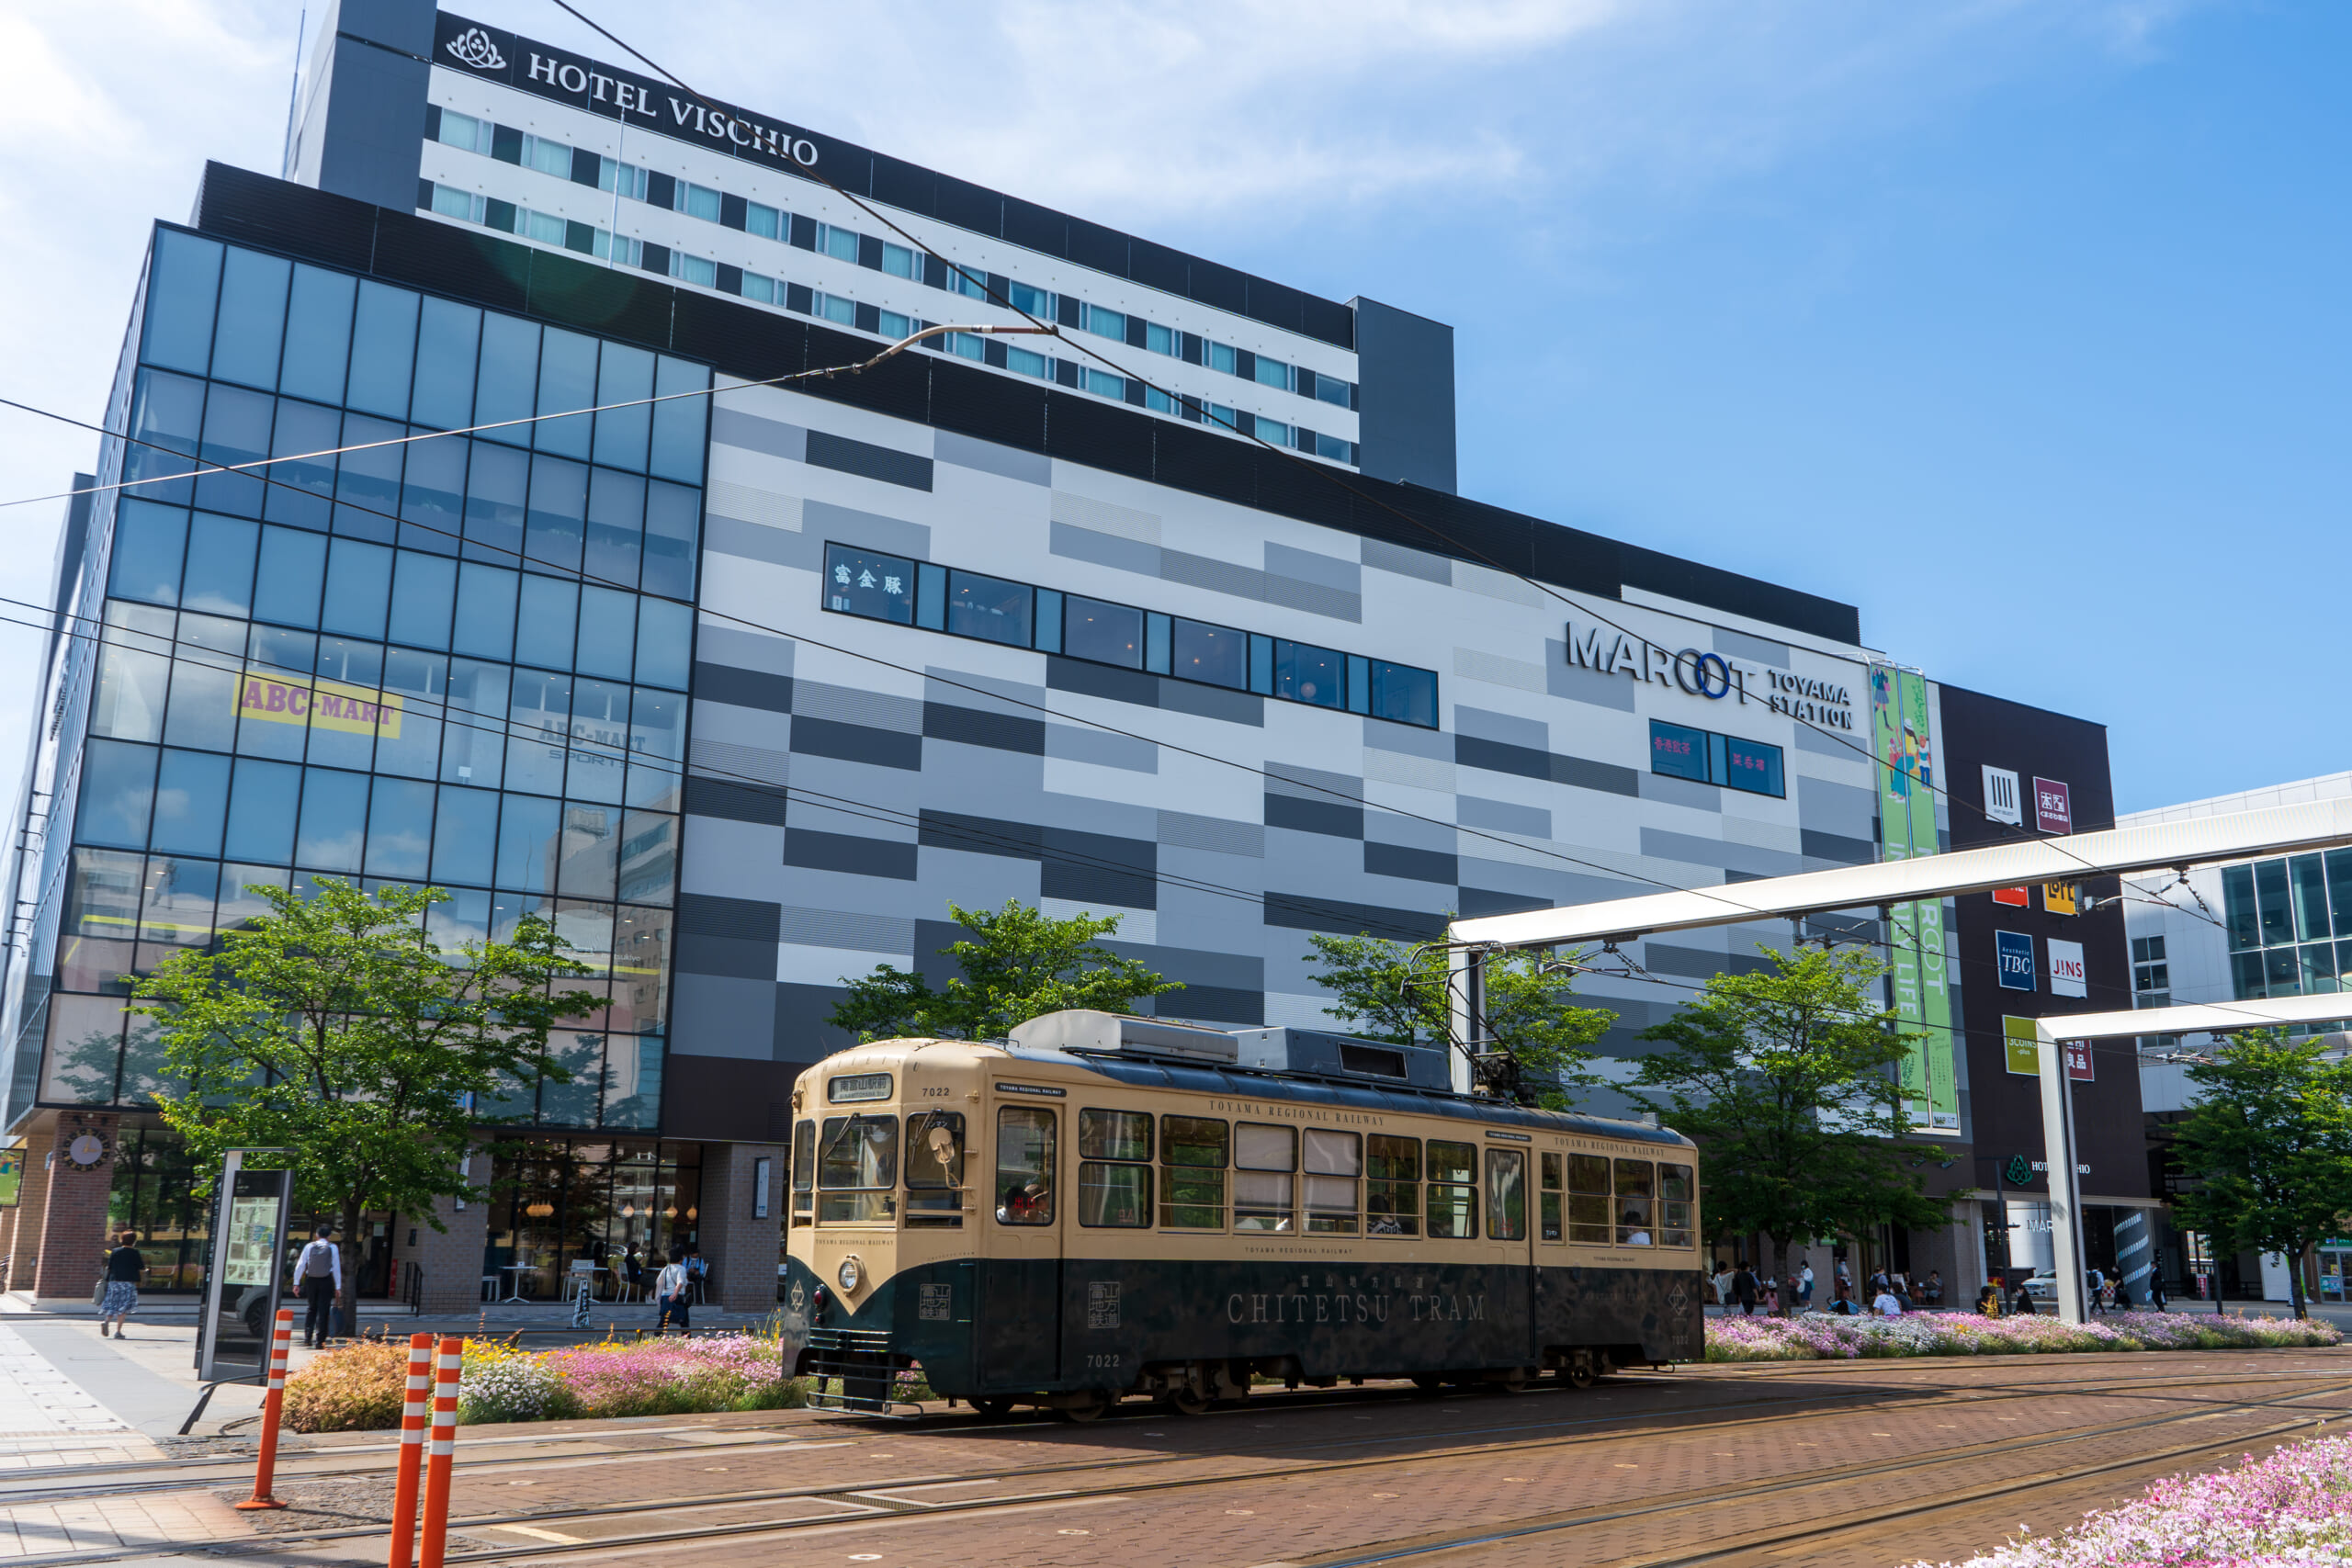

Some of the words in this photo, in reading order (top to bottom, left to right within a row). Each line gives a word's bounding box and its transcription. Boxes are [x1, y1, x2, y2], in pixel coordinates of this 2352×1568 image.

[528, 52, 657, 118] HOTEL
[667, 96, 820, 167] VISCHIO
[834, 563, 903, 595] 富金豚
[1566, 620, 1758, 705] MAROOT
[1768, 668, 1851, 706] TOYAMA
[242, 681, 395, 726] ABC-MART
[1770, 694, 1853, 729] STATION
[538, 719, 646, 753] ABC-MART
[2002, 954, 2031, 975] TBC
[1897, 962, 1917, 1015] LIFE
[839, 1077, 887, 1092] 南富山駅前
[922, 1087, 951, 1097] 7022
[1208, 1100, 1261, 1115] TOYAMA
[1268, 1106, 1329, 1122] REGIONAL
[1335, 1112, 1384, 1127] RAILWAY
[1555, 1137, 1587, 1148] TOYAMA
[1591, 1140, 1629, 1153] REGIONAL
[1633, 1145, 1664, 1157] RAILWAY
[1014, 1197, 1035, 1209] 出口
[1227, 1292, 1390, 1324] CHITETSU
[1409, 1293, 1485, 1321] TRAM
[1087, 1354, 1120, 1368] 7022
